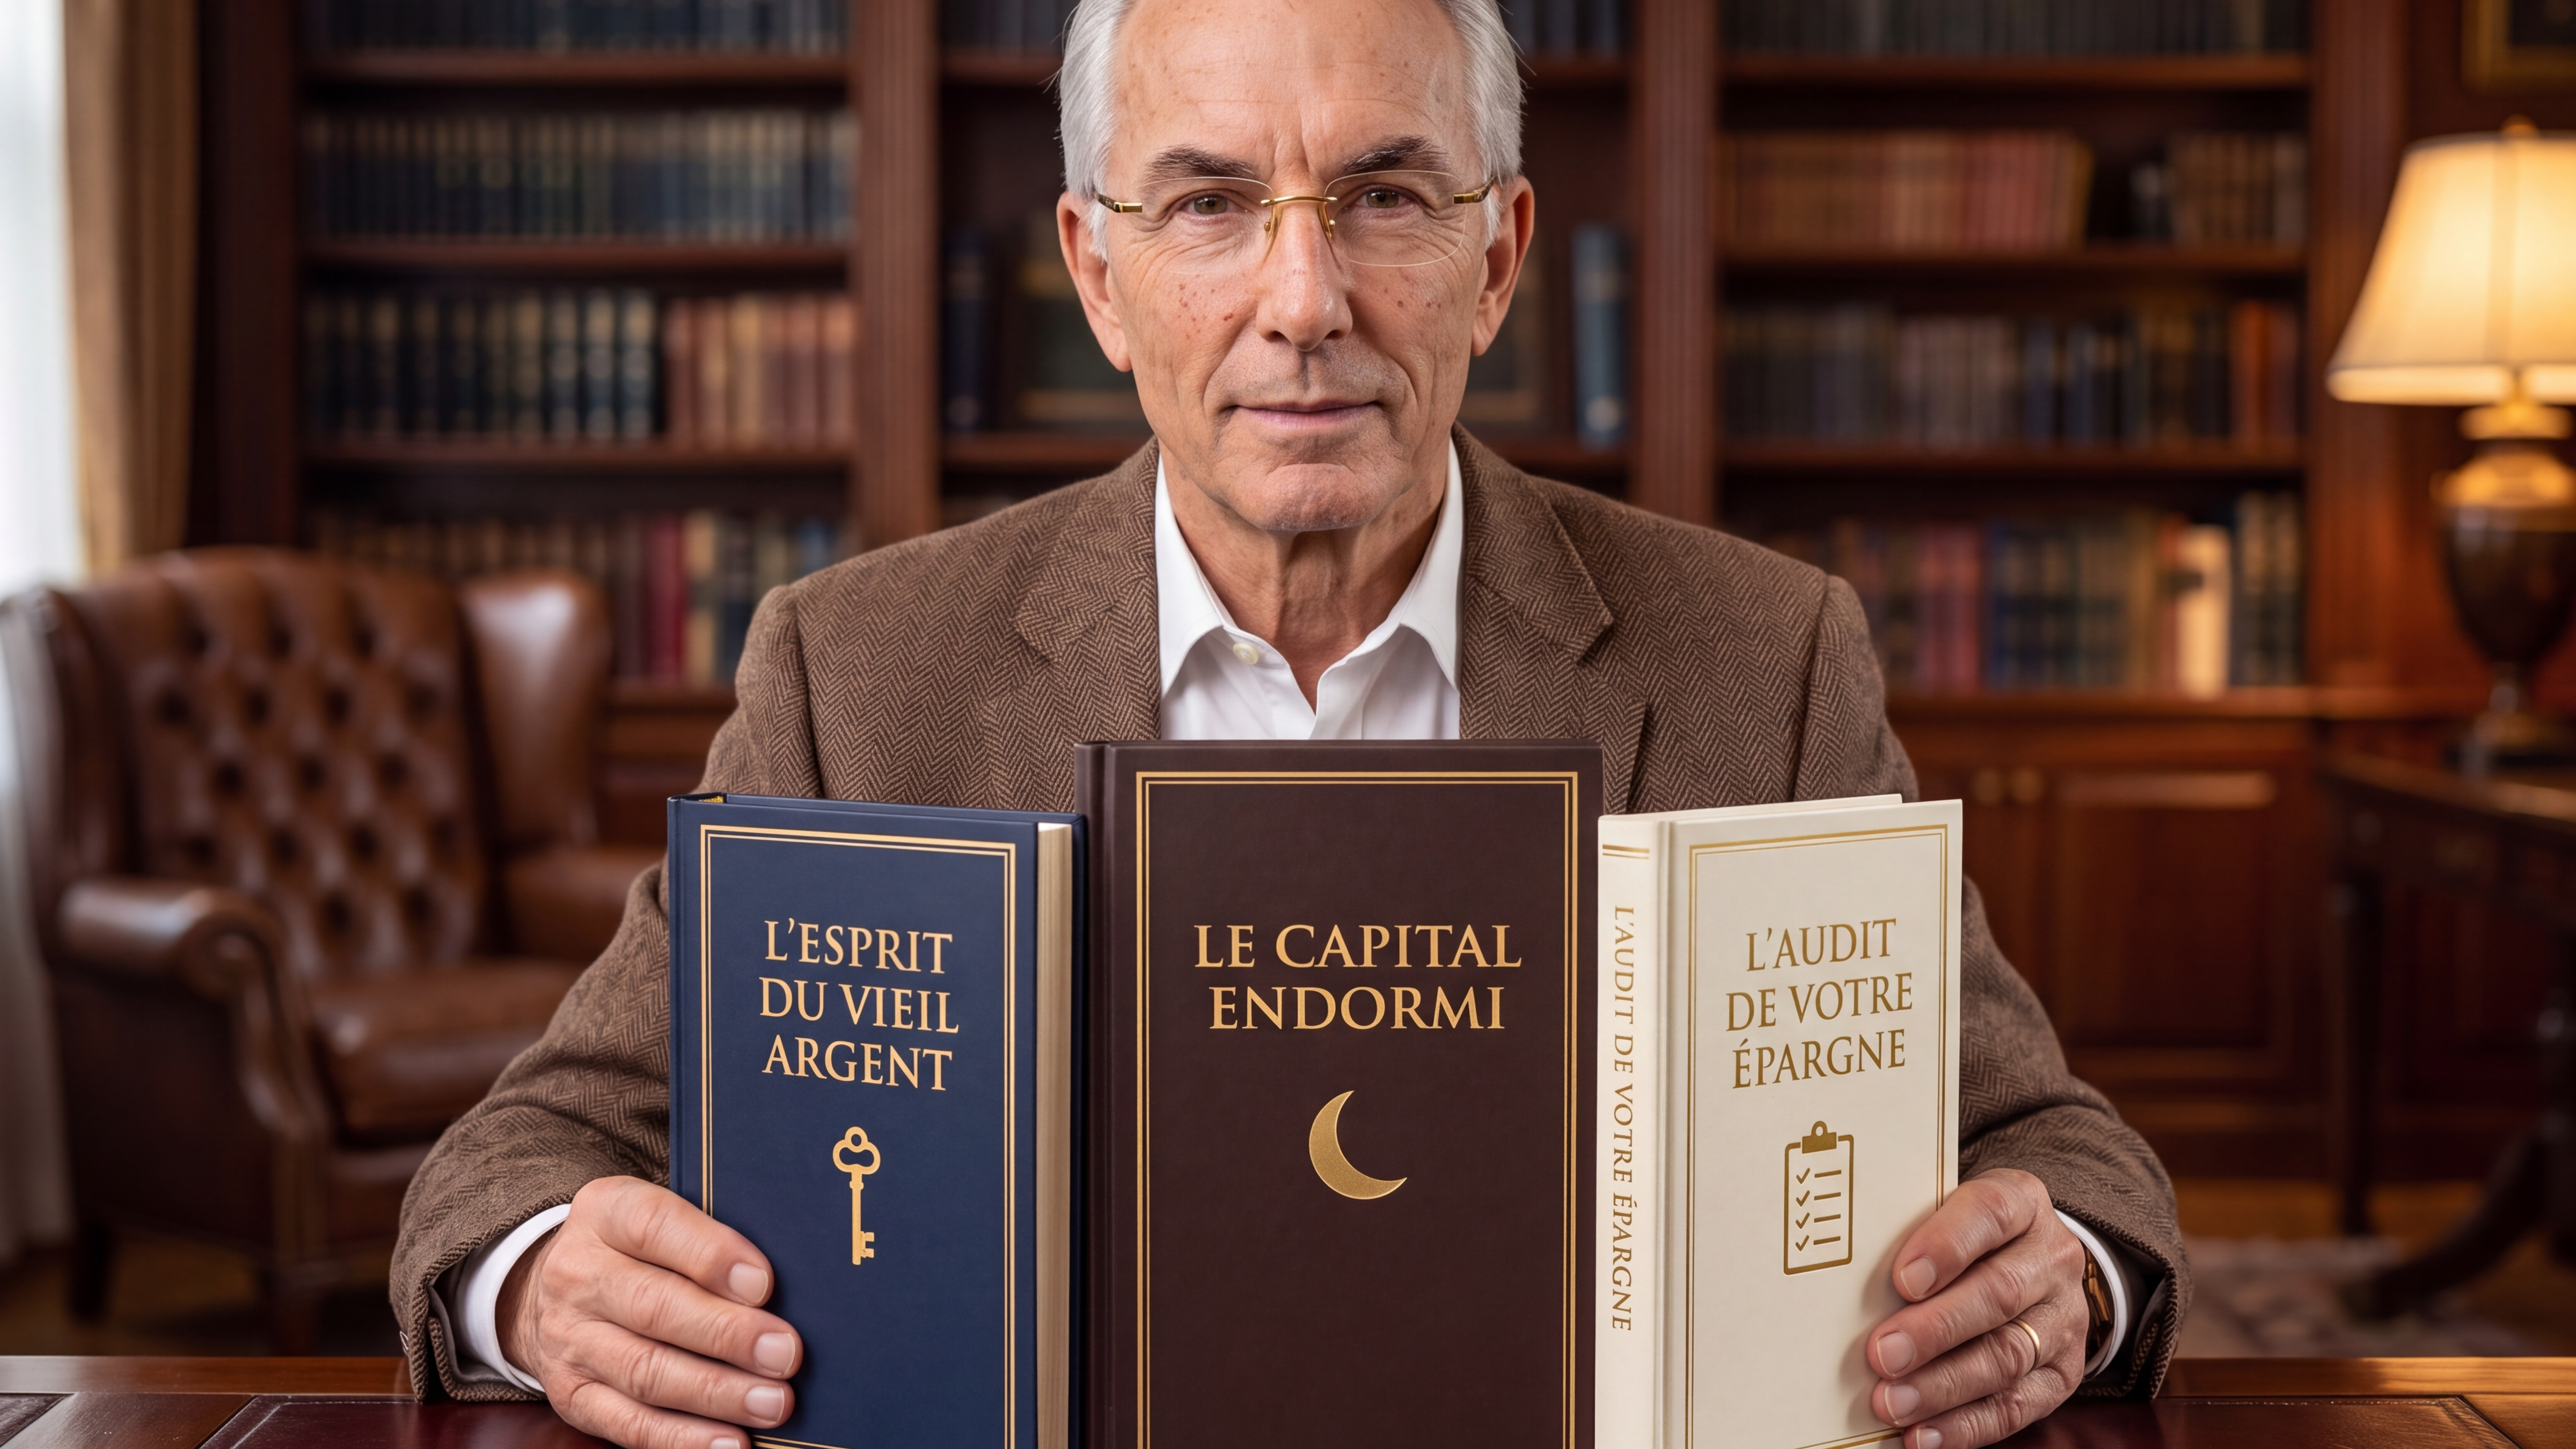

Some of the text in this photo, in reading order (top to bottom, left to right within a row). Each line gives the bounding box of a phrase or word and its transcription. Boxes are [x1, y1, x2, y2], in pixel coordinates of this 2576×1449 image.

[765, 917, 953, 974] L’ESPRIT
[1194, 923, 1523, 969] LE CAPITAL
[1746, 918, 1897, 972] L’AUDIT
[759, 977, 960, 1034] DU VIEIL
[1209, 985, 1505, 1030] ENDORMI
[1726, 972, 1913, 1032] DE VOTRE
[762, 1034, 953, 1091] ARGENT
[1732, 1028, 1906, 1089] ÉPARGNE
[1612, 905, 1638, 1331] L’AUDIT DE VOTRE ÉPARGNE
